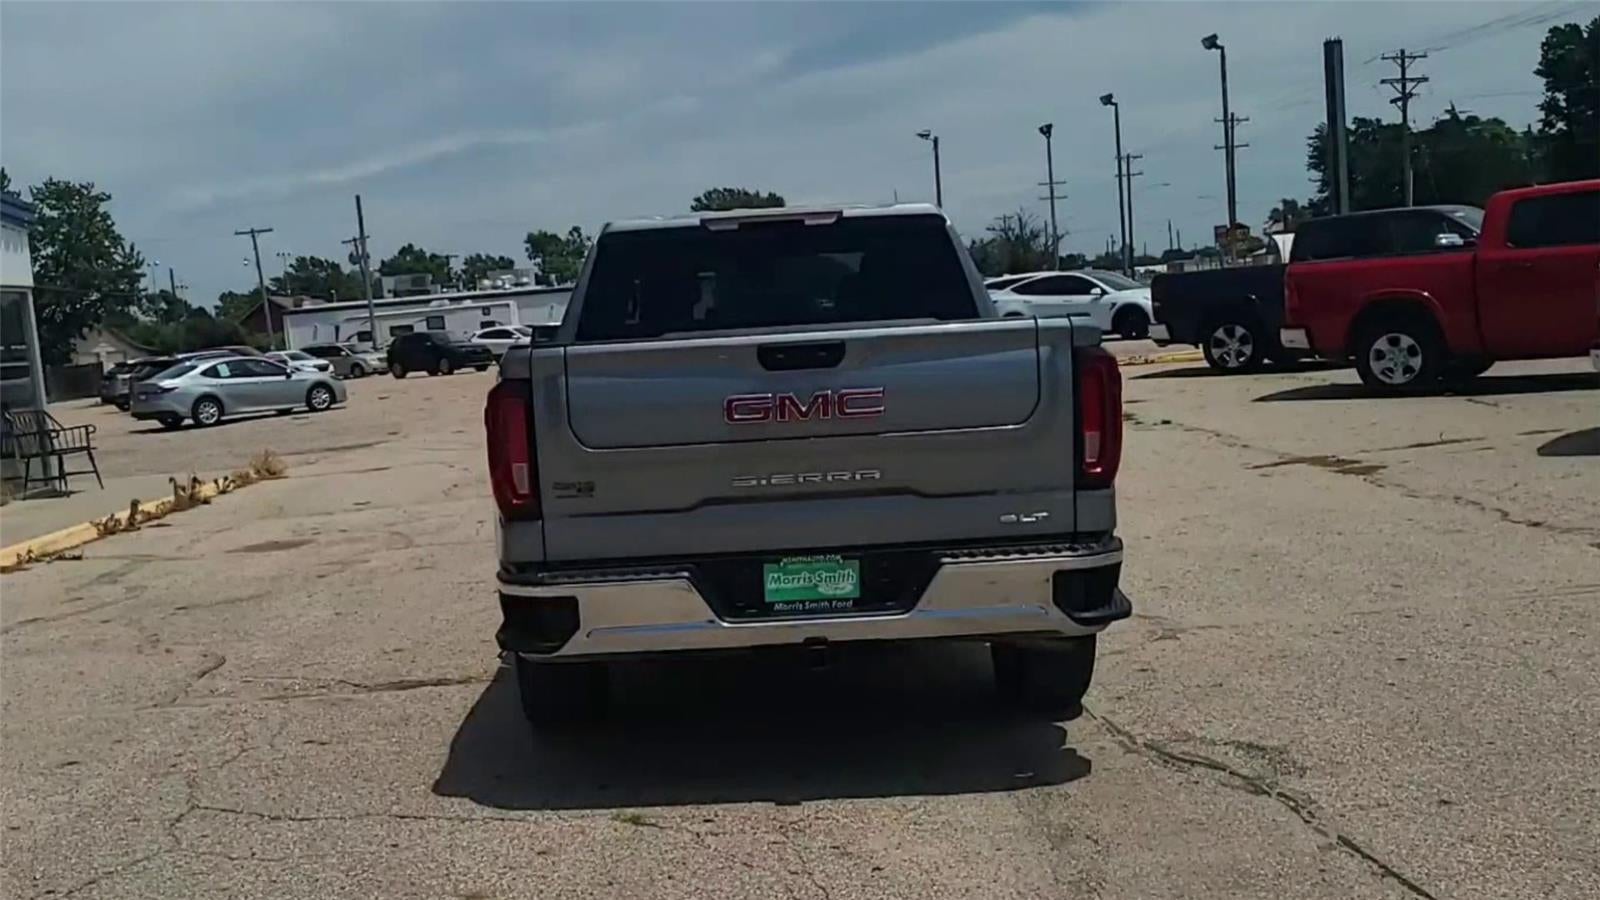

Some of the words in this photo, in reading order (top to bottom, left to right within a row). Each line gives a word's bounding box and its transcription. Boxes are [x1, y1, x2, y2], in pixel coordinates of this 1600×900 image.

[725, 387, 885, 424] GMC
[732, 469, 881, 487] SIERRA
[768, 572, 814, 587] Morris
[815, 569, 856, 584] Smith
[774, 602, 802, 611] Morris
[804, 601, 830, 609] Smith
[832, 600, 853, 608] Ford
